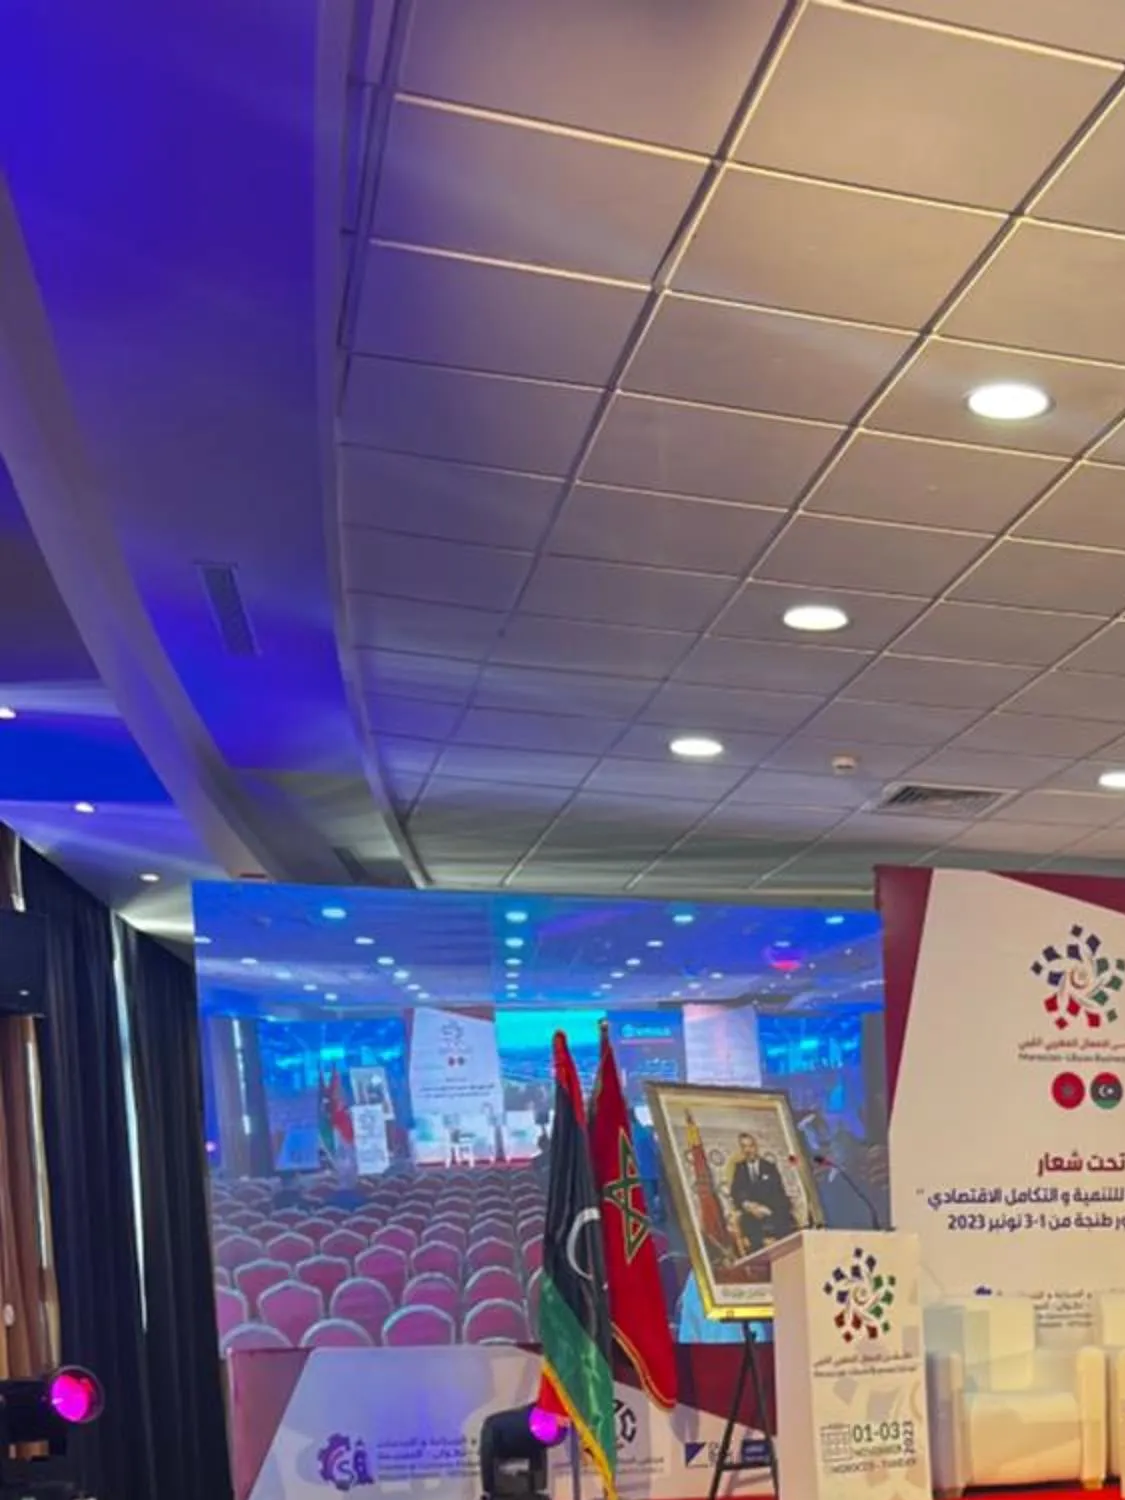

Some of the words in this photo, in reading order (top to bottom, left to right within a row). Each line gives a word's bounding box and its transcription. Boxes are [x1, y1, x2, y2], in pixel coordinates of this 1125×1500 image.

[1037, 1150, 1084, 1177] شعار
[1004, 1187, 1058, 1206] التكامل
[1073, 1187, 1125, 1207] للتنمية
[947, 1213, 986, 1230] 2023
[1049, 1213, 1072, 1231] من
[1074, 1210, 1114, 1231] طنجة
[852, 1420, 901, 1443] 01-03
